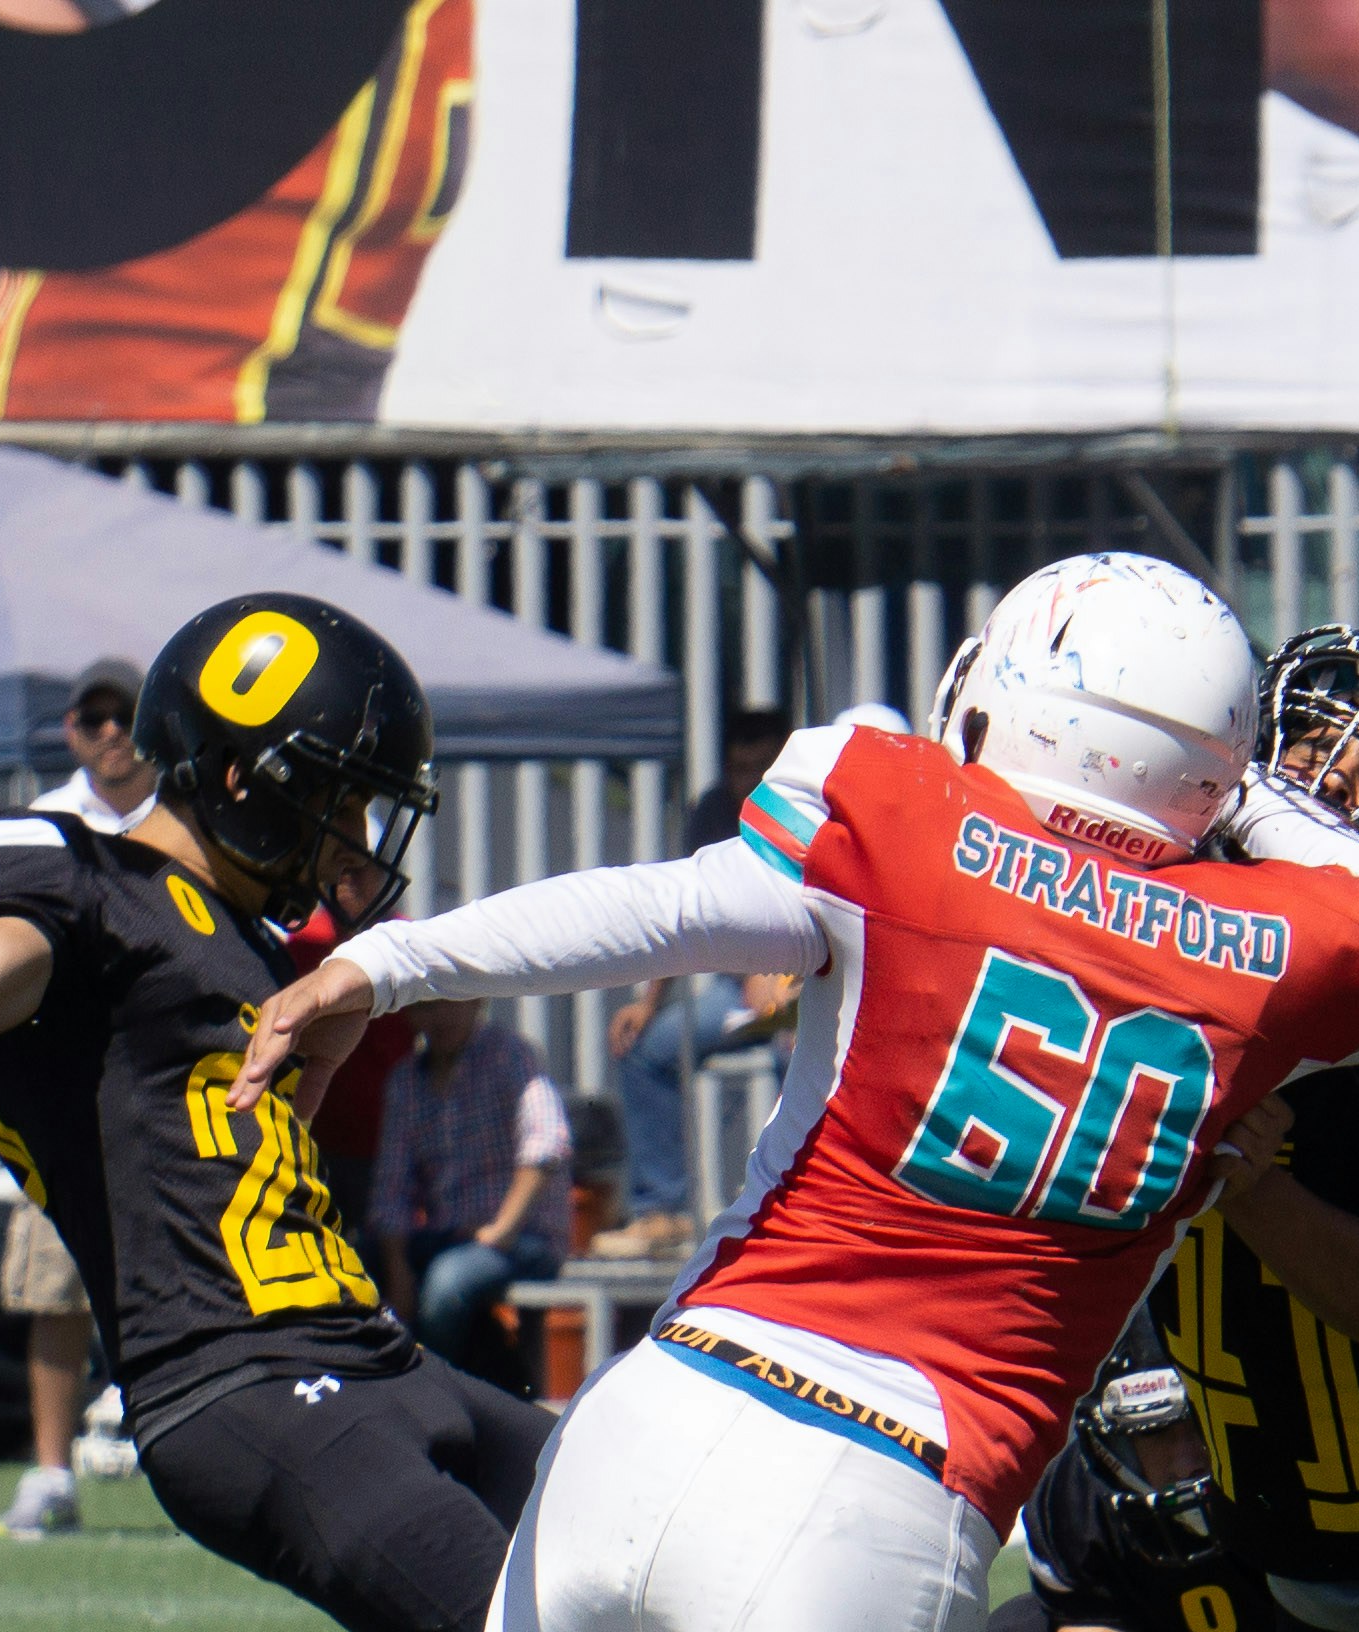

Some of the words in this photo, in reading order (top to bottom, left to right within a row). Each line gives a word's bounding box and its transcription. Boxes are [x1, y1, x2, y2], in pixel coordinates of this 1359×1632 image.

[952, 808, 1292, 983] STRATFORD
[1047, 801, 1168, 864] Riddell
[892, 946, 1217, 1232] 60
